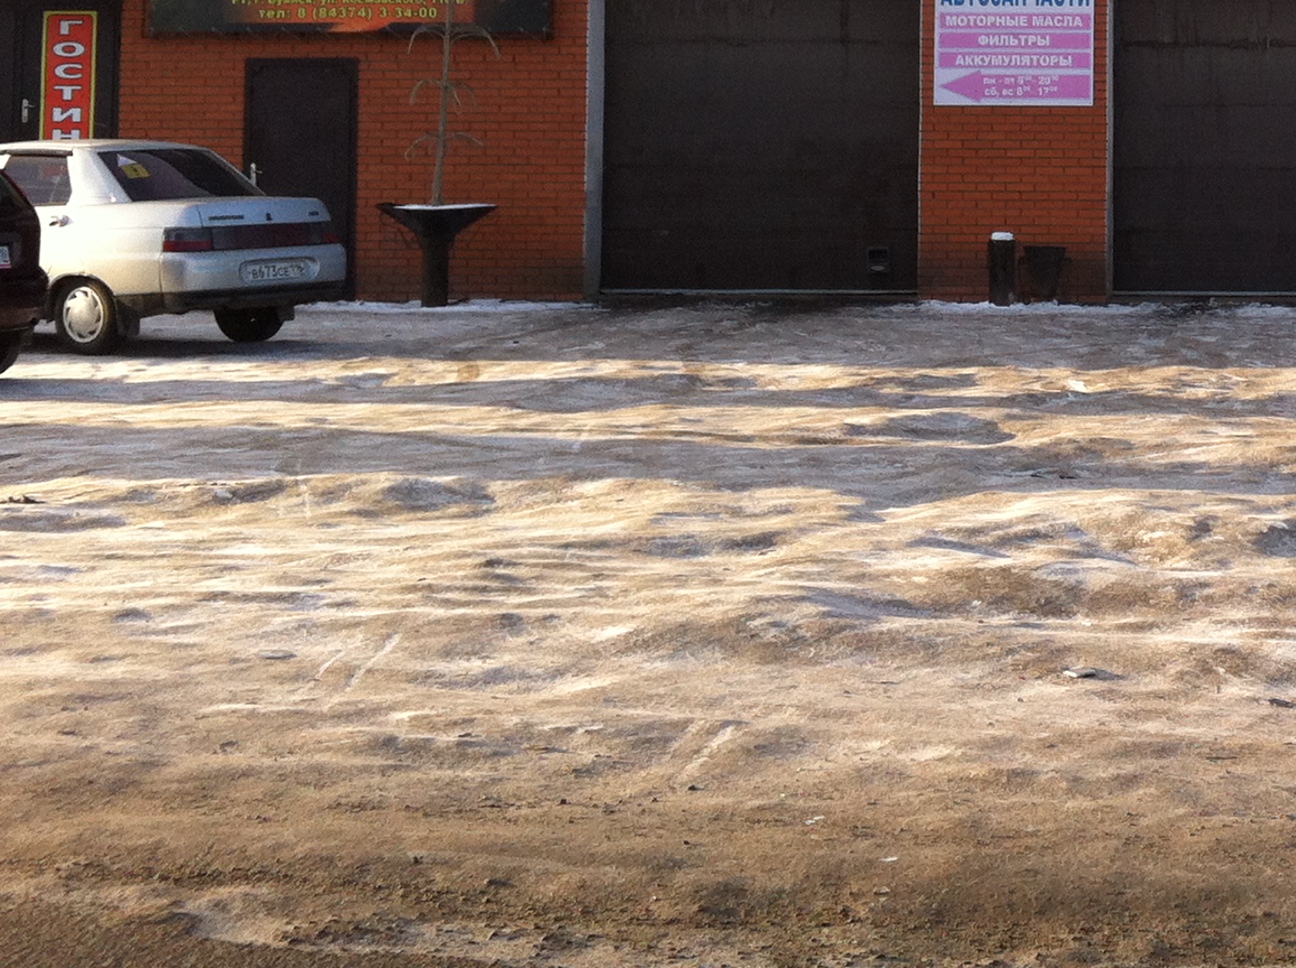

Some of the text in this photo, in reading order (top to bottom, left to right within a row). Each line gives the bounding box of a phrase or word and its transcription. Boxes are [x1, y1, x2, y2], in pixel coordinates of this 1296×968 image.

[945, 15, 1083, 27] МОТОРНЫЕ МАСЛА
[977, 34, 1050, 47] ФИЛЬТРЫ
[955, 54, 1073, 67] АККУМУЛЯТОРЫ
